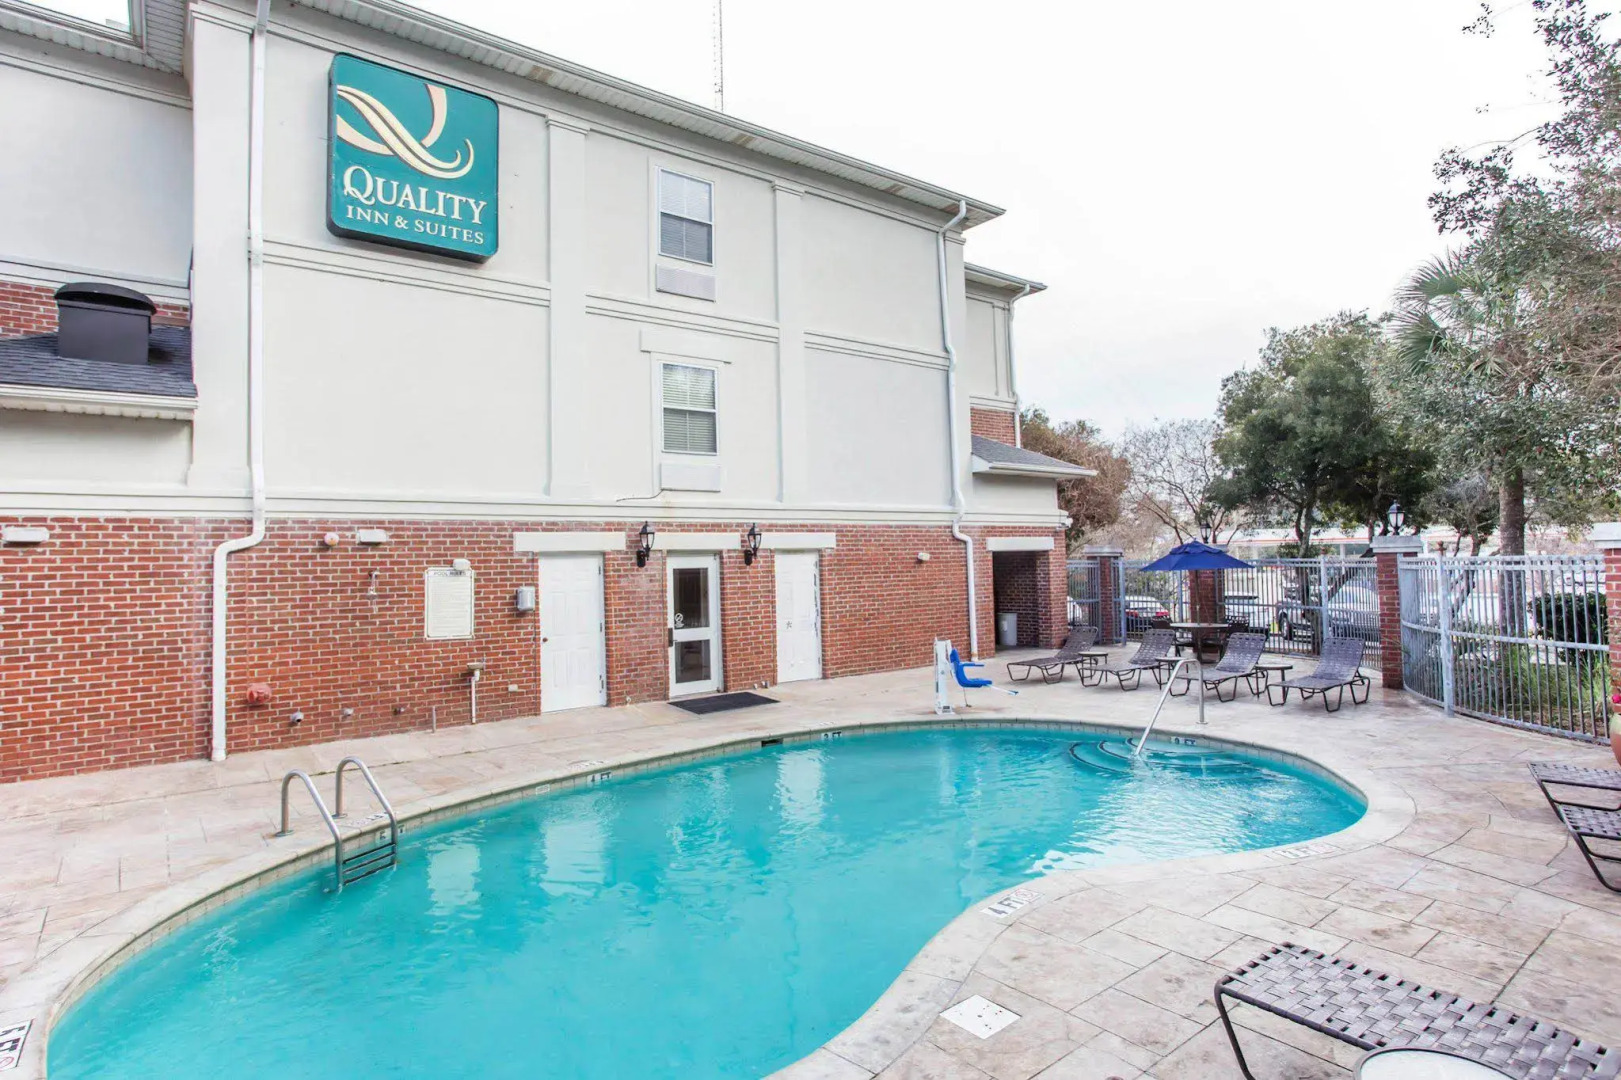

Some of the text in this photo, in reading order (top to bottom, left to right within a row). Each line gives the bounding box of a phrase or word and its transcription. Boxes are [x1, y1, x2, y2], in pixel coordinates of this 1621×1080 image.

[343, 165, 488, 225] QUALITY
[346, 205, 485, 245] INN & SUITES
